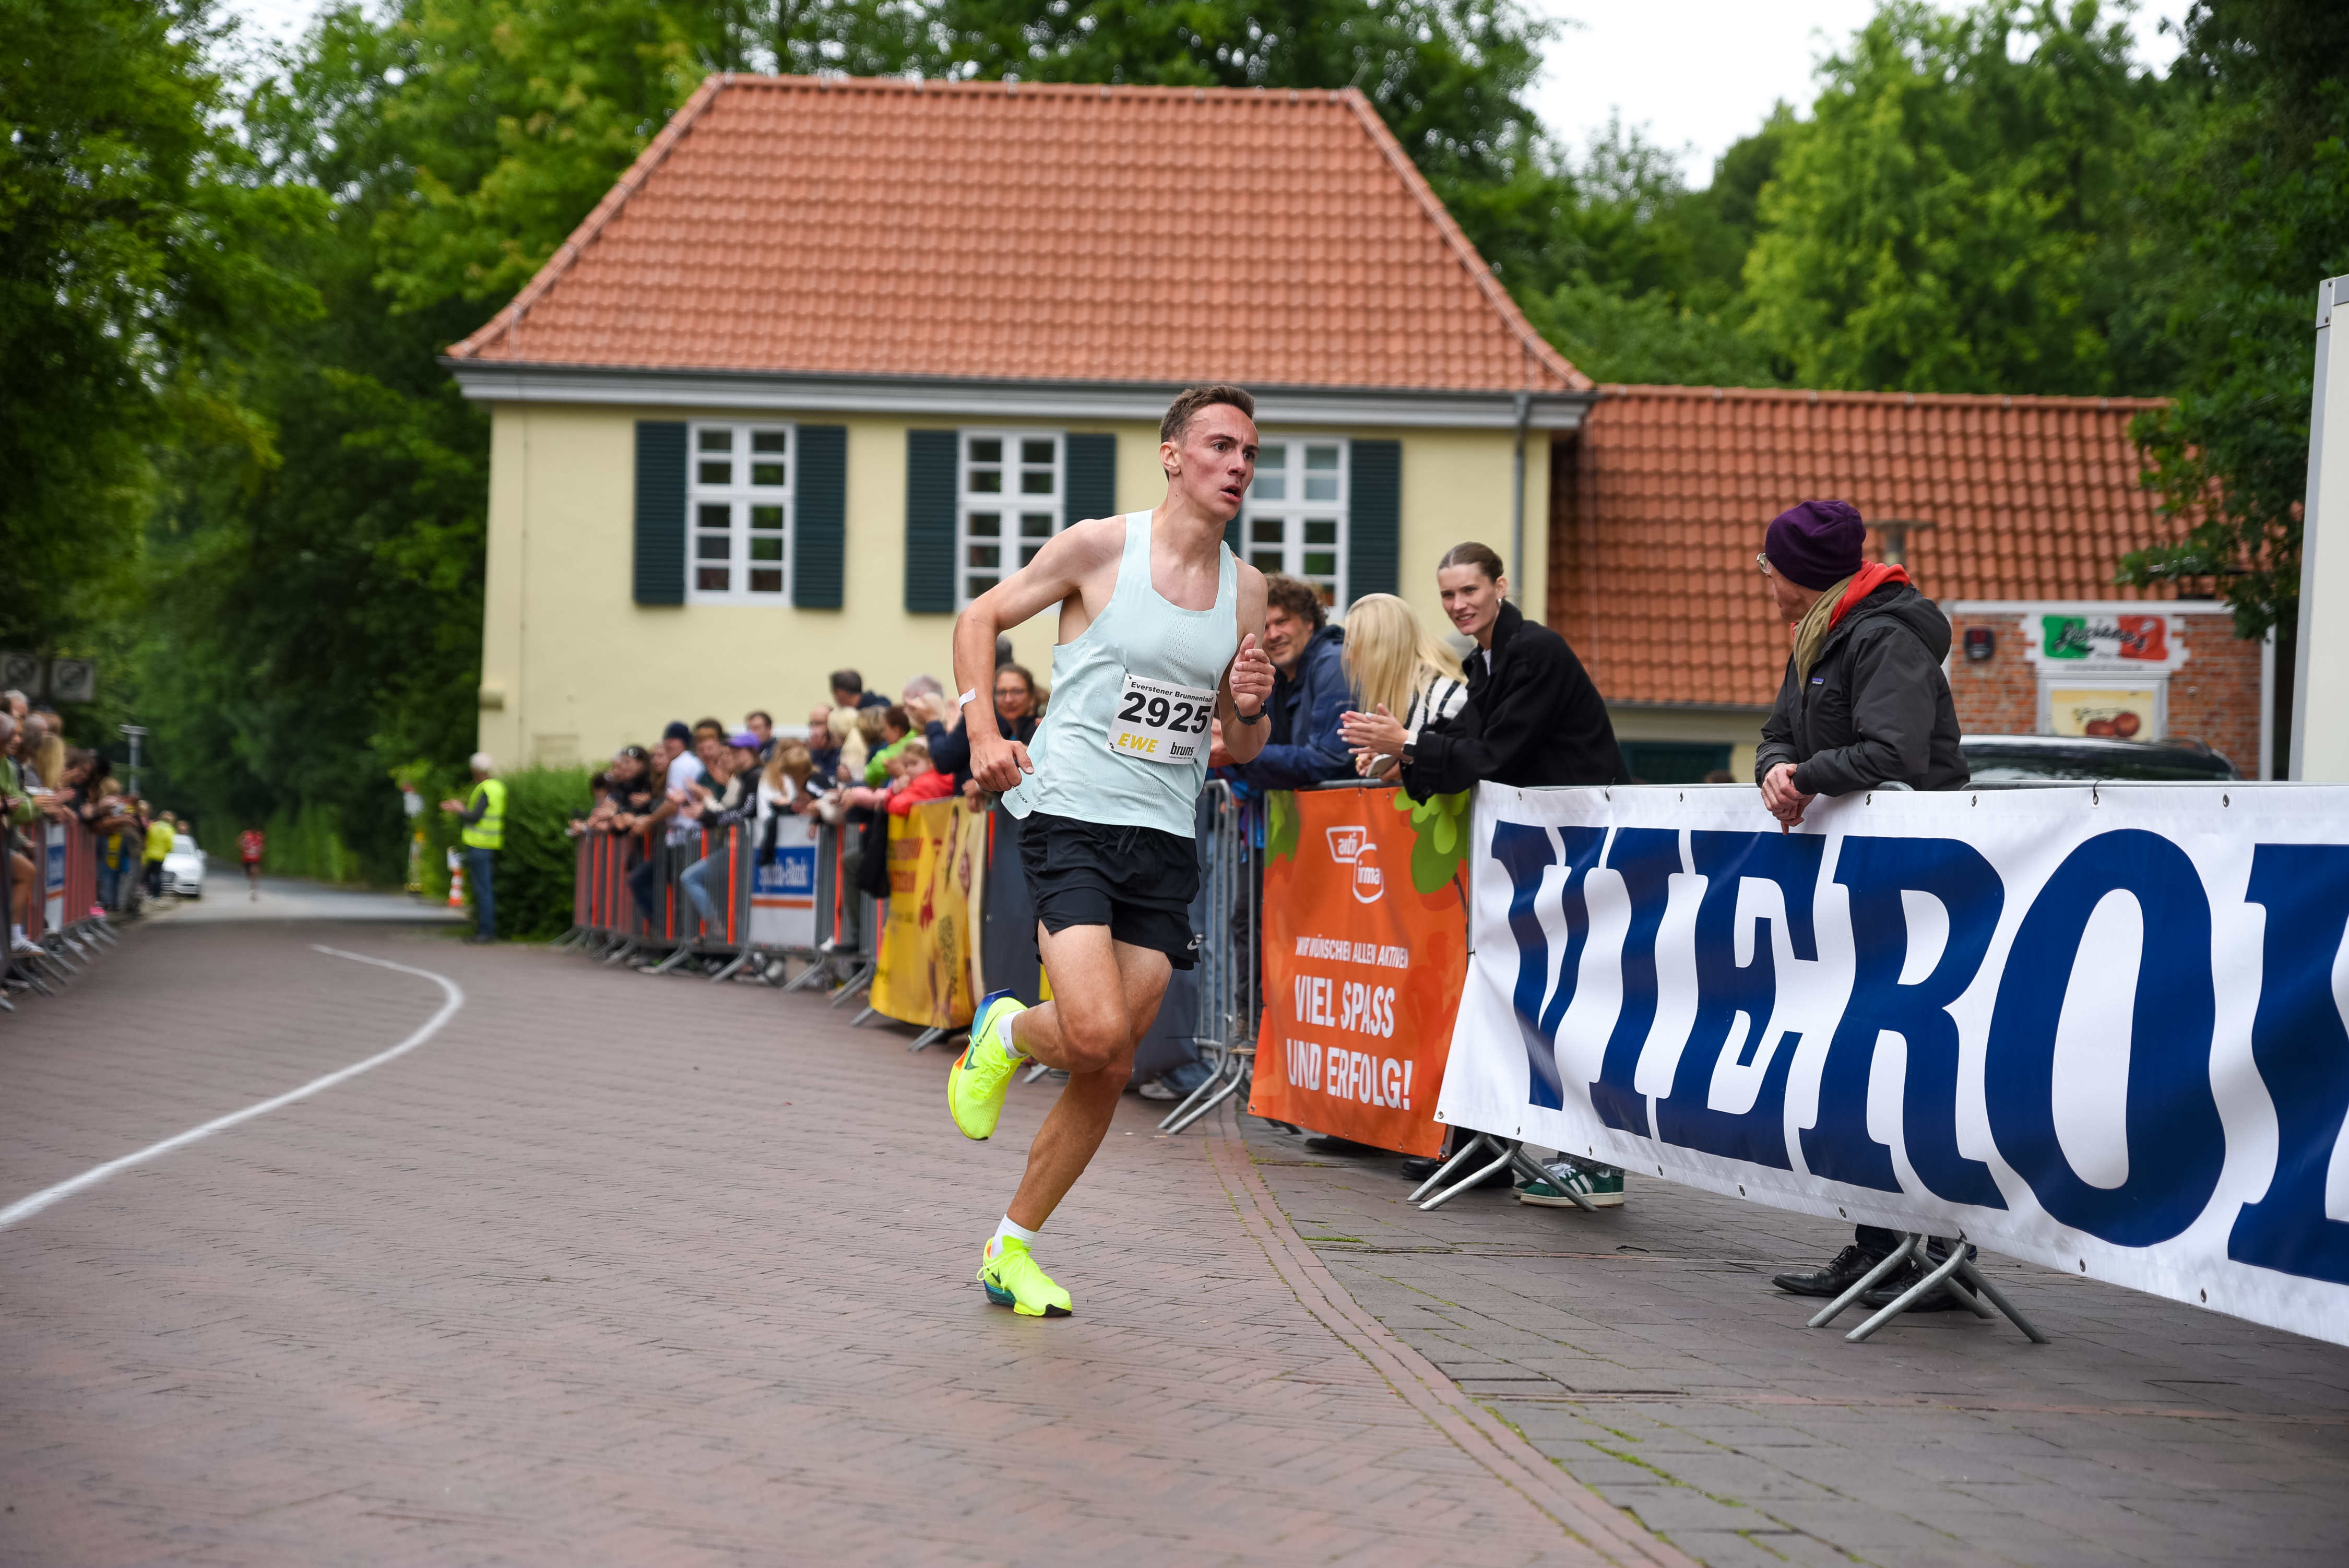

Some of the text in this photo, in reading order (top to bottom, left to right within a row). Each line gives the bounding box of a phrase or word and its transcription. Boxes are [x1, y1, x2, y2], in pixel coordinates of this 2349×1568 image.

[1131, 681, 1214, 703] Everstener Brunnenlauf
[1117, 692, 1212, 734] 2925
[1117, 732, 1159, 753] EWE
[1170, 741, 1195, 756] bruns
[1294, 974, 1395, 1038] VIEL SPASS
[1286, 1038, 1413, 1111] UND ERFOLG!
